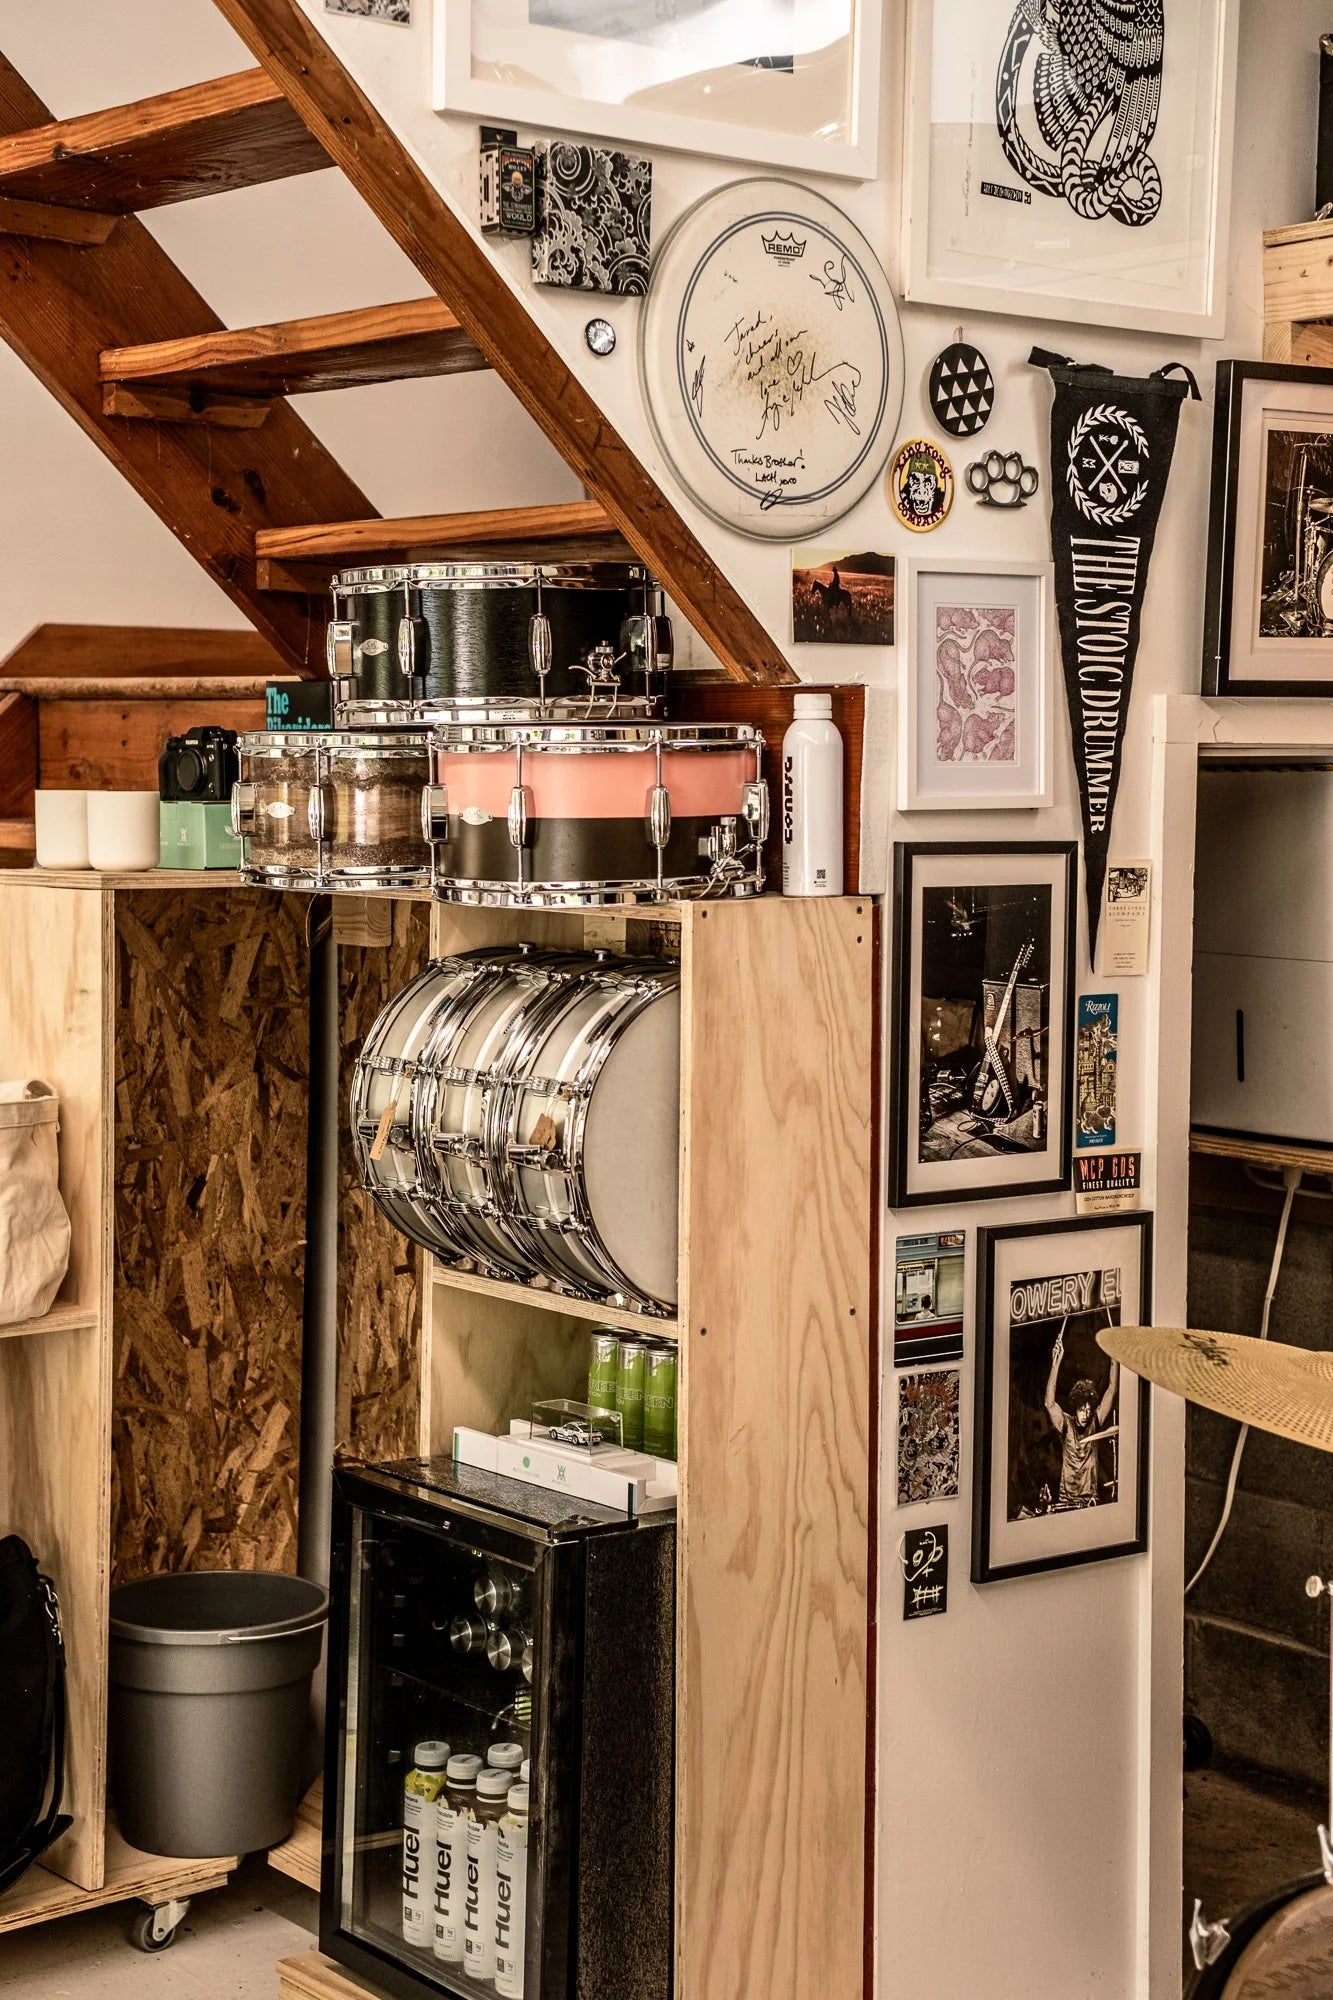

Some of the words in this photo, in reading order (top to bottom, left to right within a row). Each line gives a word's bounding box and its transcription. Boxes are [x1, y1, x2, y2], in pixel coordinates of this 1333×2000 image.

[505, 212, 532, 222] WORLD
[768, 243, 801, 254] REMO
[731, 448, 763, 466] Thanks
[1070, 535, 1141, 595] THE
[1074, 598, 1132, 683] STOIC
[266, 687, 289, 715] The
[1080, 687, 1121, 835] DRUMMER
[1080, 1158, 1104, 1181] MCP
[1082, 1181, 1103, 1190] FINEST
[1107, 1179, 1135, 1189] QUALITY
[1010, 1271, 1094, 1320] OWERY
[402, 1825, 420, 1900] Huel
[434, 1838, 452, 1917] Huel
[464, 1854, 479, 1932] Huel
[495, 1869, 512, 1949] Huel
